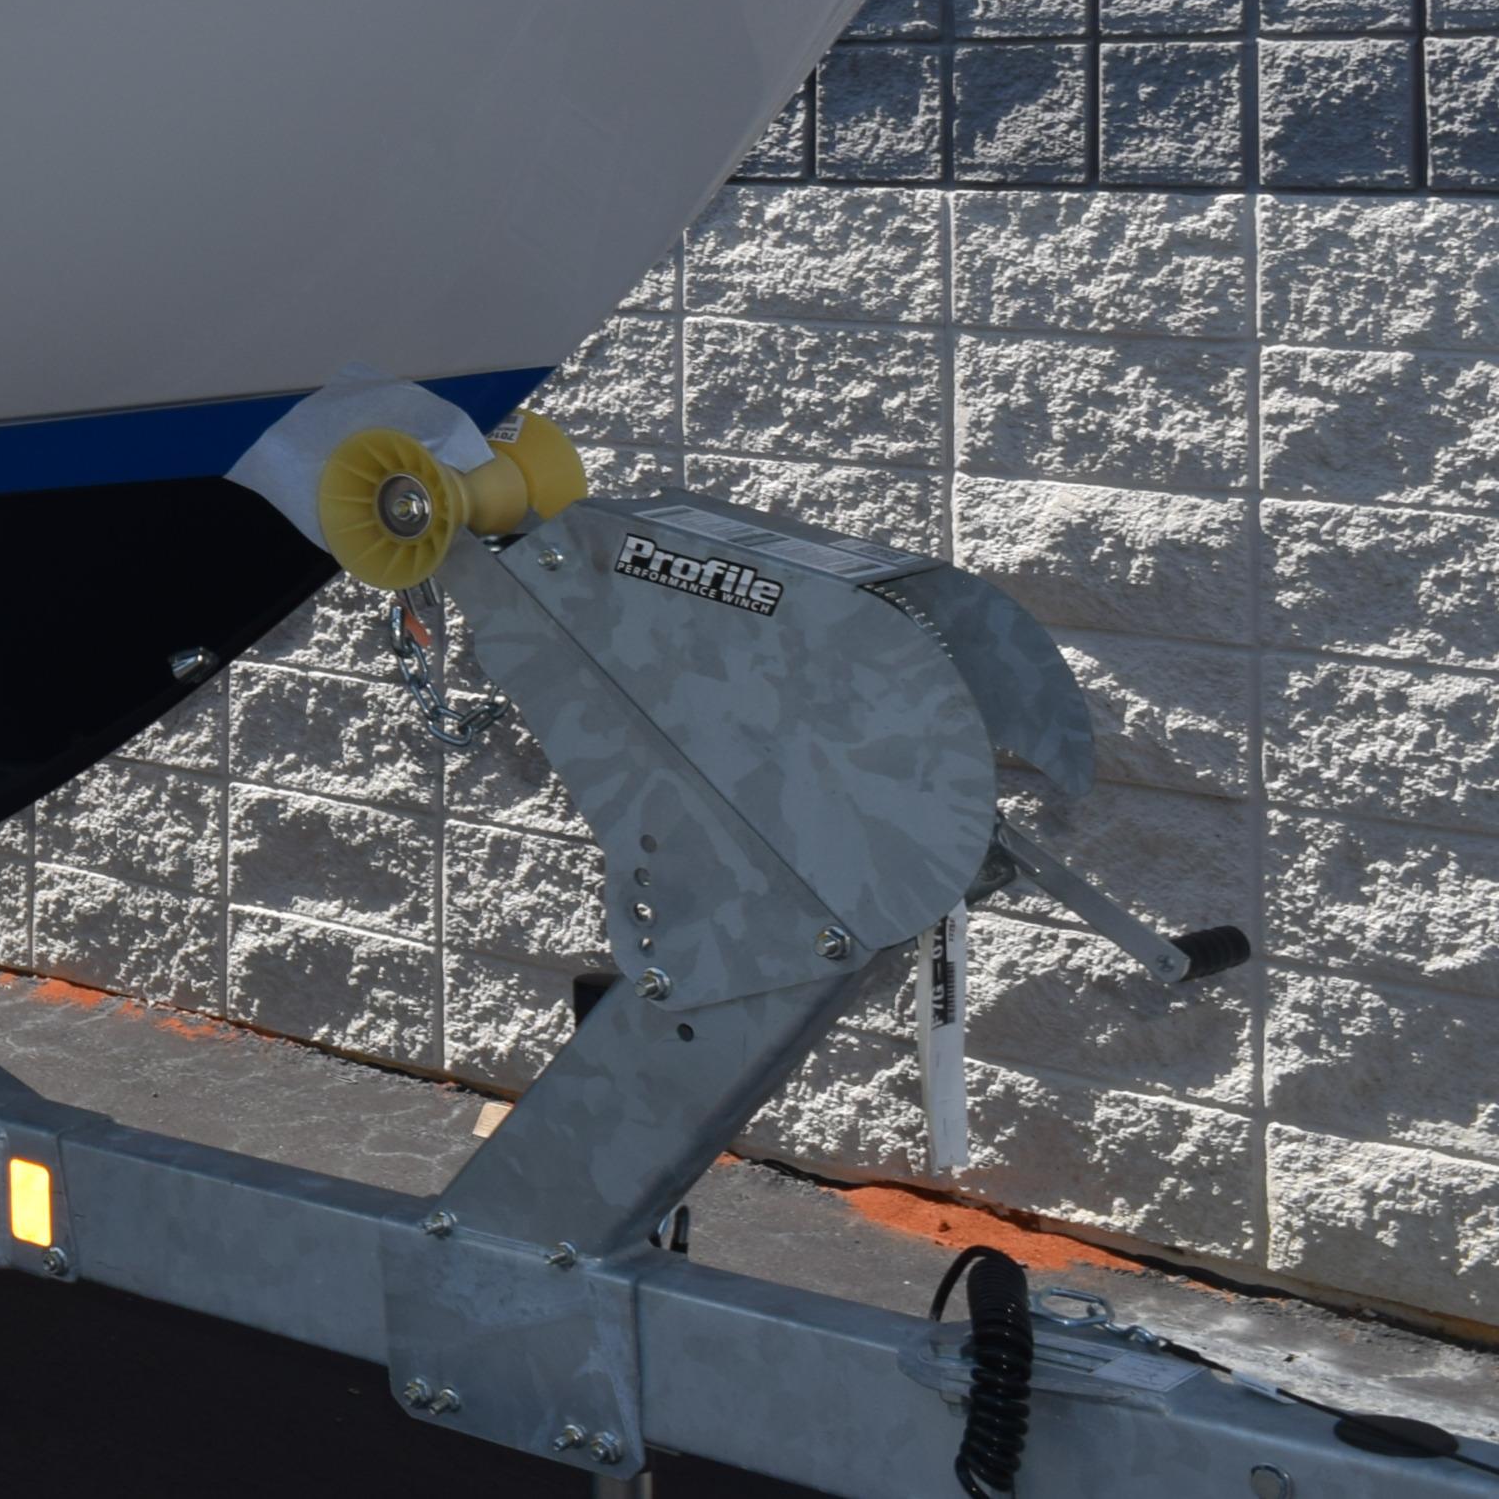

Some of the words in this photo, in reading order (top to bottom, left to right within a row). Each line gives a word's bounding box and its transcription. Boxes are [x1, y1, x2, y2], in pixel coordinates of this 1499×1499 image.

[616, 562, 717, 599] PERFORMANCE
[722, 592, 771, 614] WINCH
[618, 535, 781, 605] Profile
